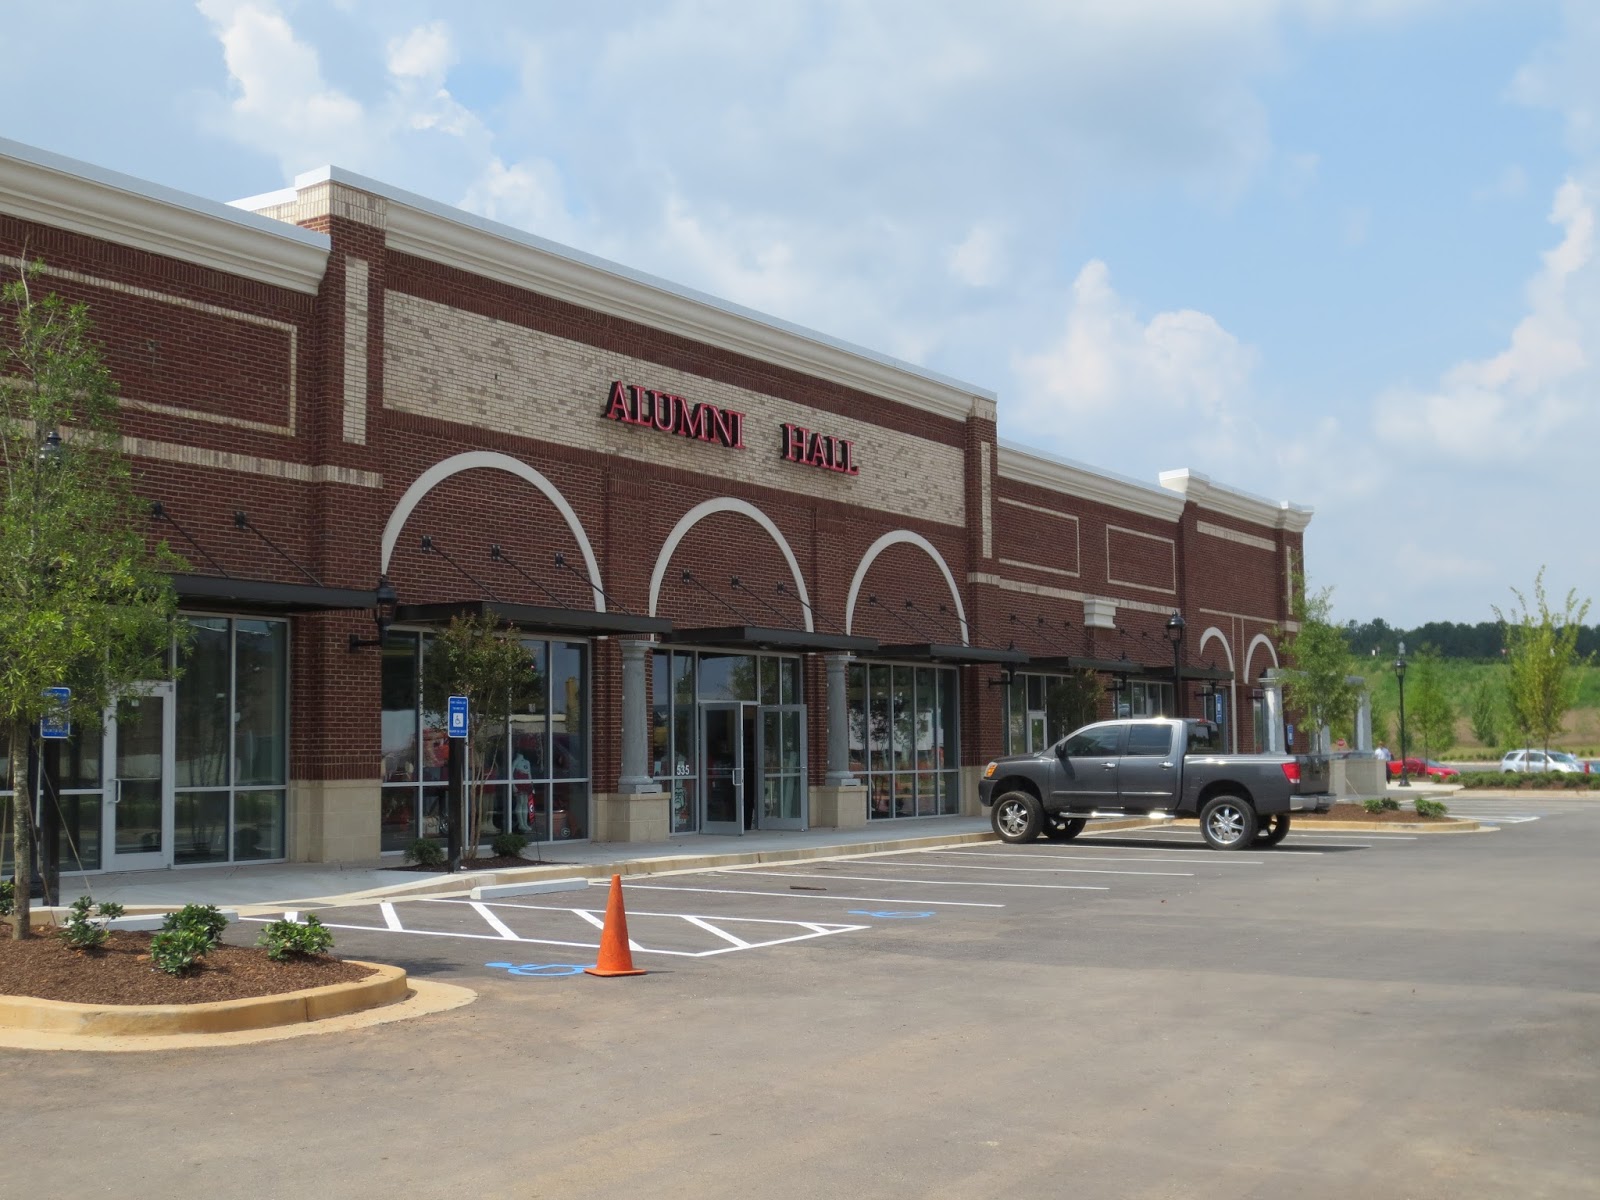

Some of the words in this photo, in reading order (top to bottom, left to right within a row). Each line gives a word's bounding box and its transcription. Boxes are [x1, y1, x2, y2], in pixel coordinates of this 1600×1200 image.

[602, 380, 745, 449] ALUMNI
[780, 423, 859, 475] HALL
[676, 764, 690, 776] 535
